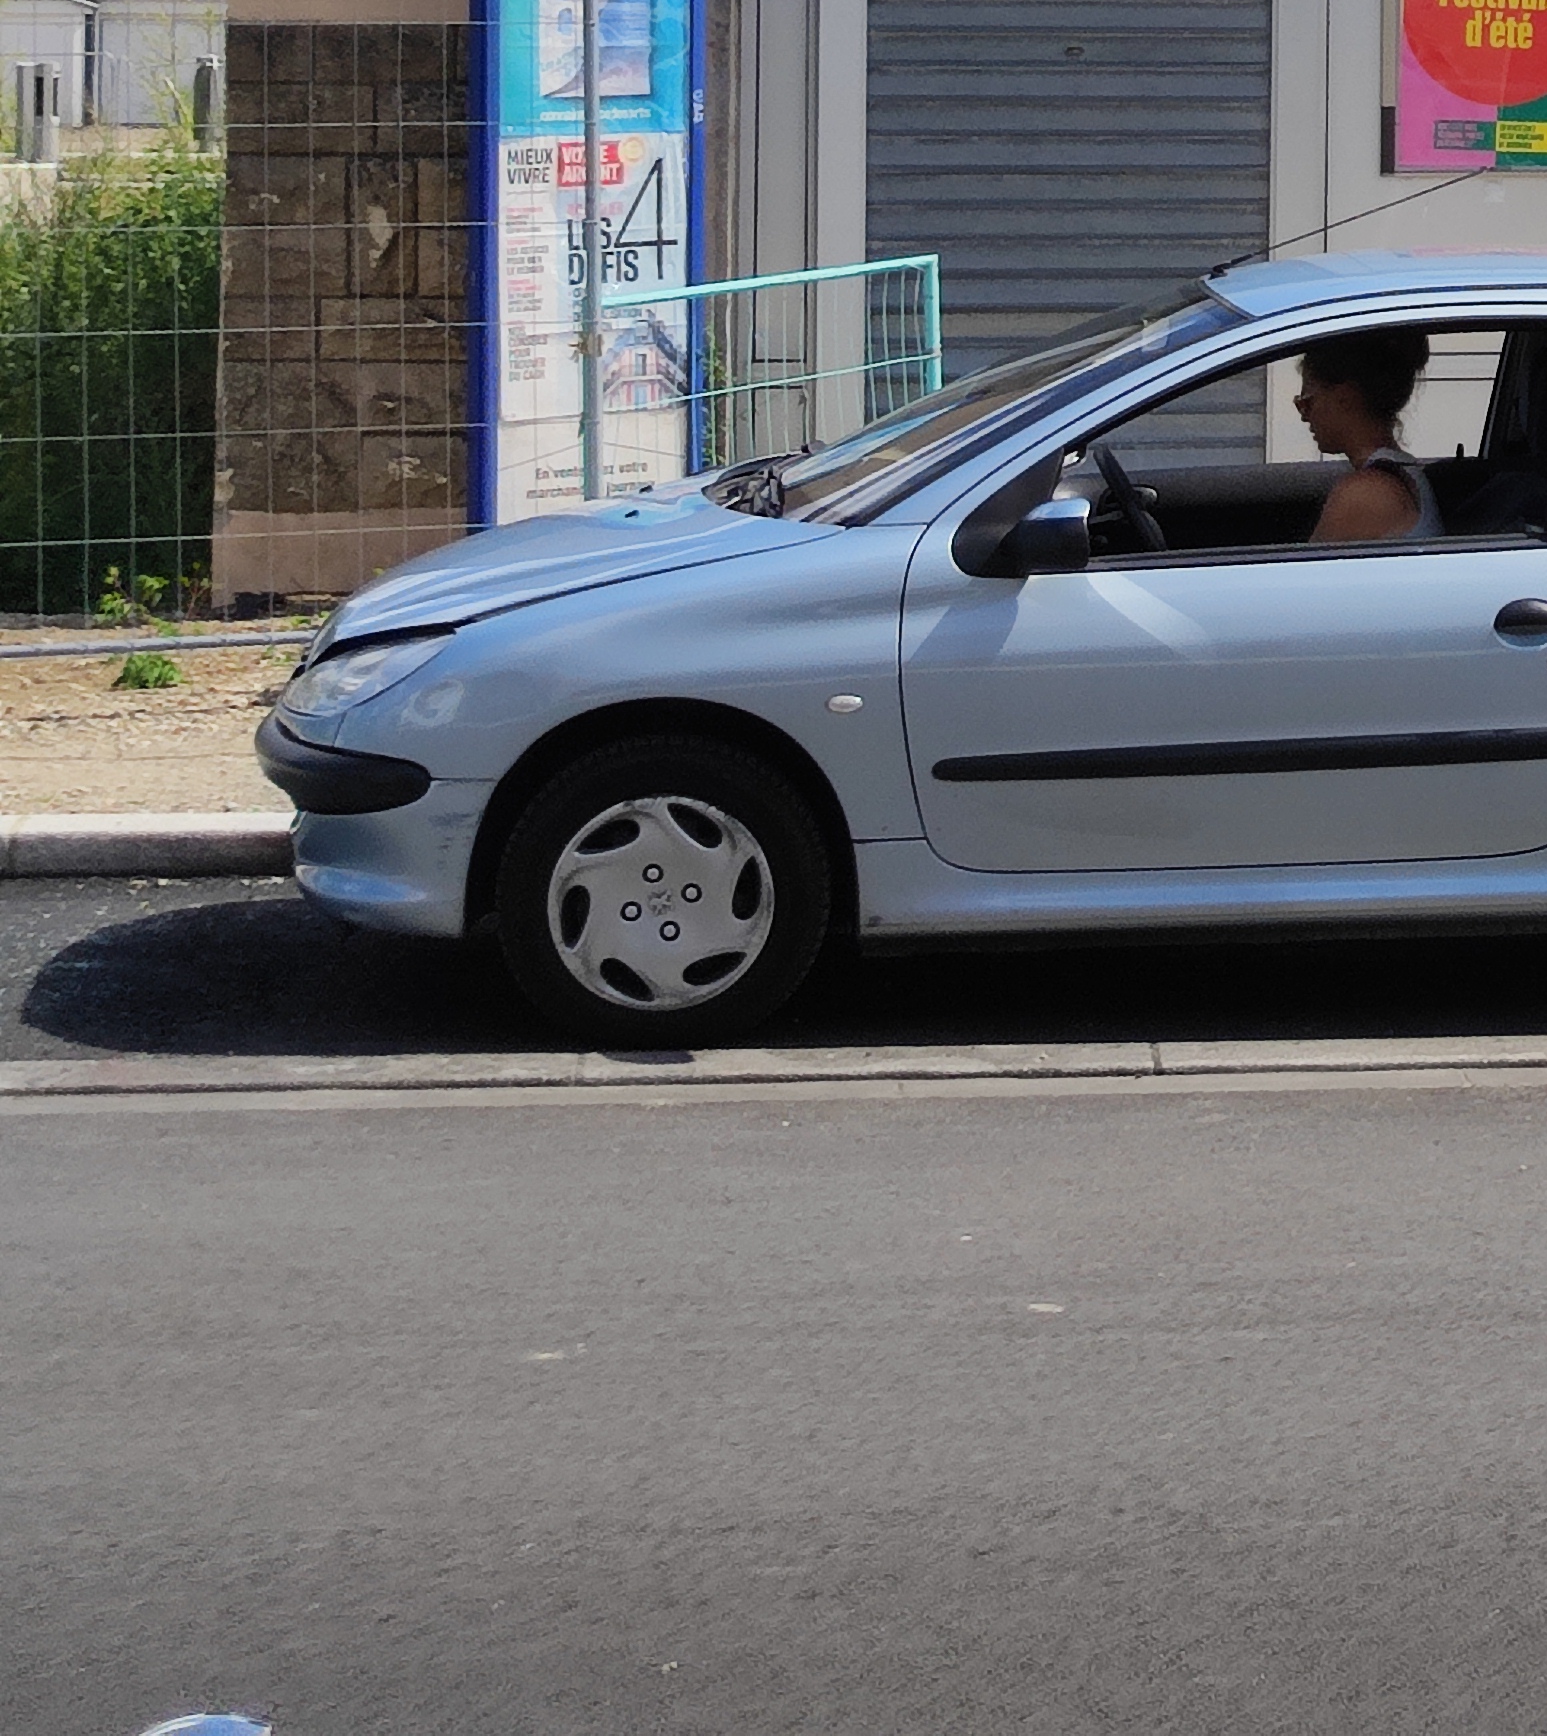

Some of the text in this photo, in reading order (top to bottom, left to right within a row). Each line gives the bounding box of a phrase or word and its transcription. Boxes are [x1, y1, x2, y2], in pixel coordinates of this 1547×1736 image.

[1465, 10, 1533, 49] d'été
[507, 148, 553, 166] MIEUX
[562, 144, 609, 164] VOE
[507, 167, 550, 185] VIVRE
[567, 157, 678, 281] LS 4
[568, 249, 639, 286] DFIS
[535, 467, 549, 480] En
